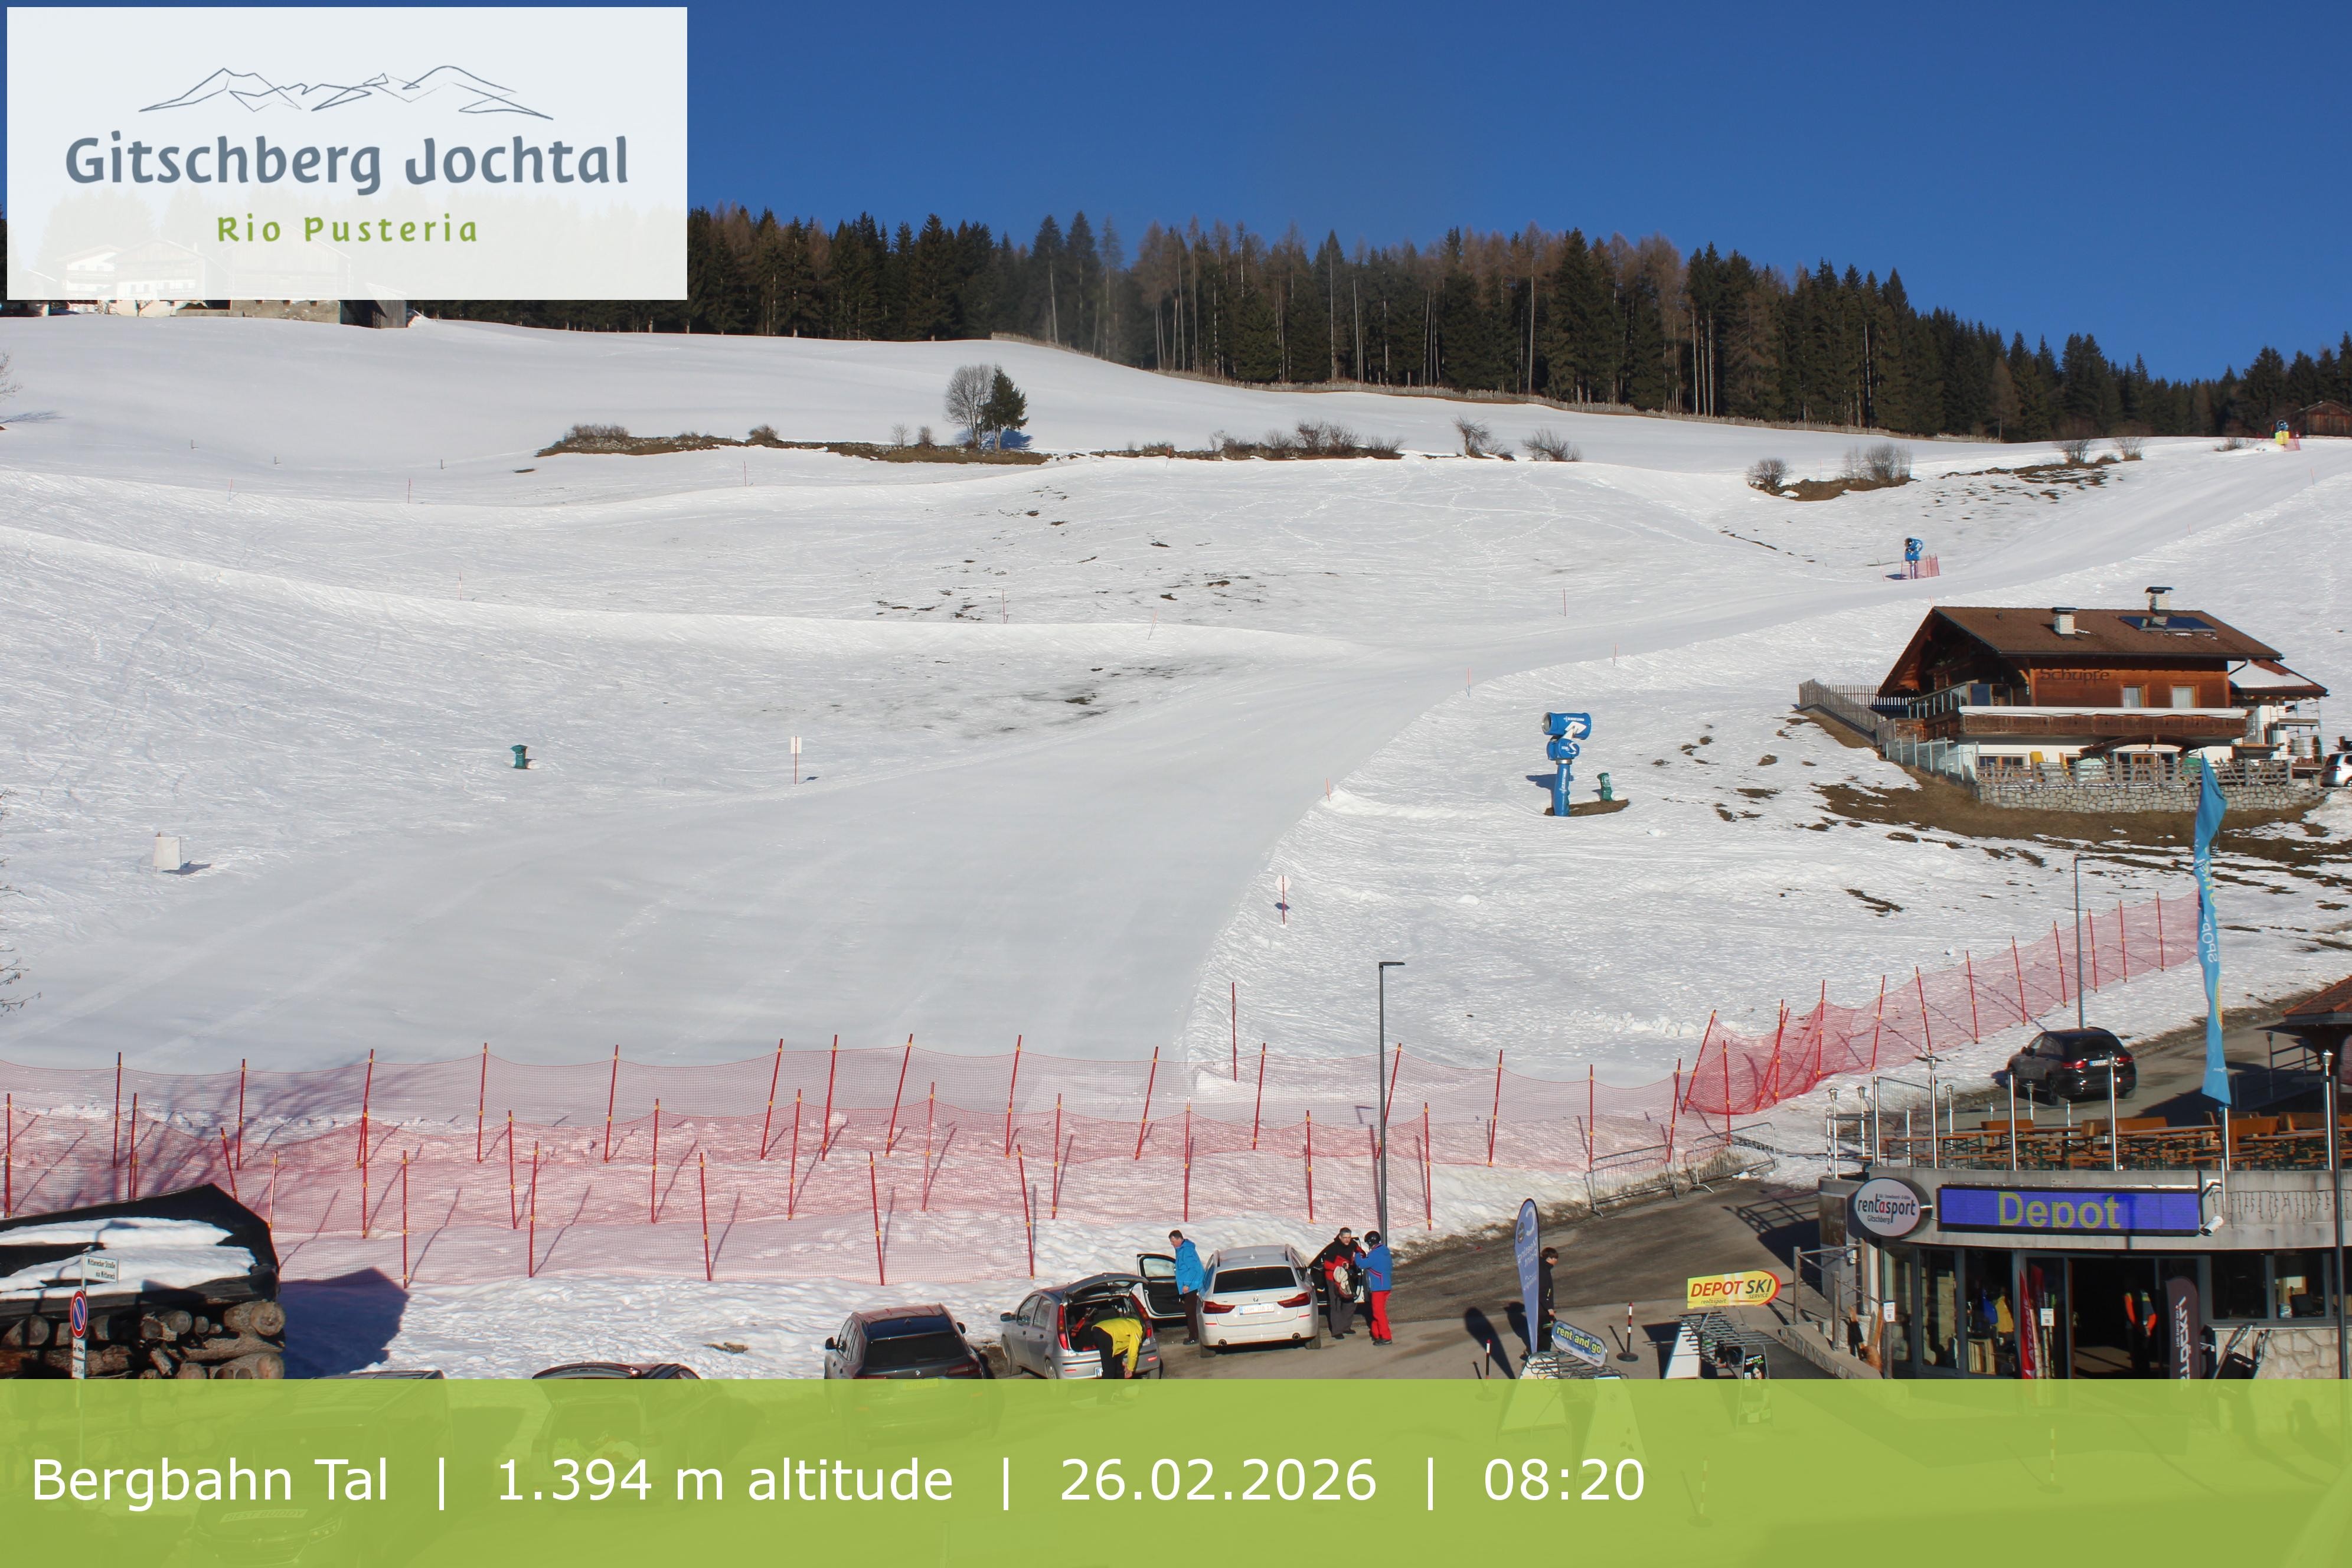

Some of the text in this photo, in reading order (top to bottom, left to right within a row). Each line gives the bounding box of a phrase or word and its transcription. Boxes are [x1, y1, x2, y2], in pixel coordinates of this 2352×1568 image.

[1858, 1193, 1916, 1223] rentasport
[1867, 1214, 1890, 1225] Gitschberg
[1998, 1191, 2121, 1229] Depot
[1690, 1278, 1772, 1297] DEPOT SKI
[1556, 1325, 1602, 1354] rent and go
